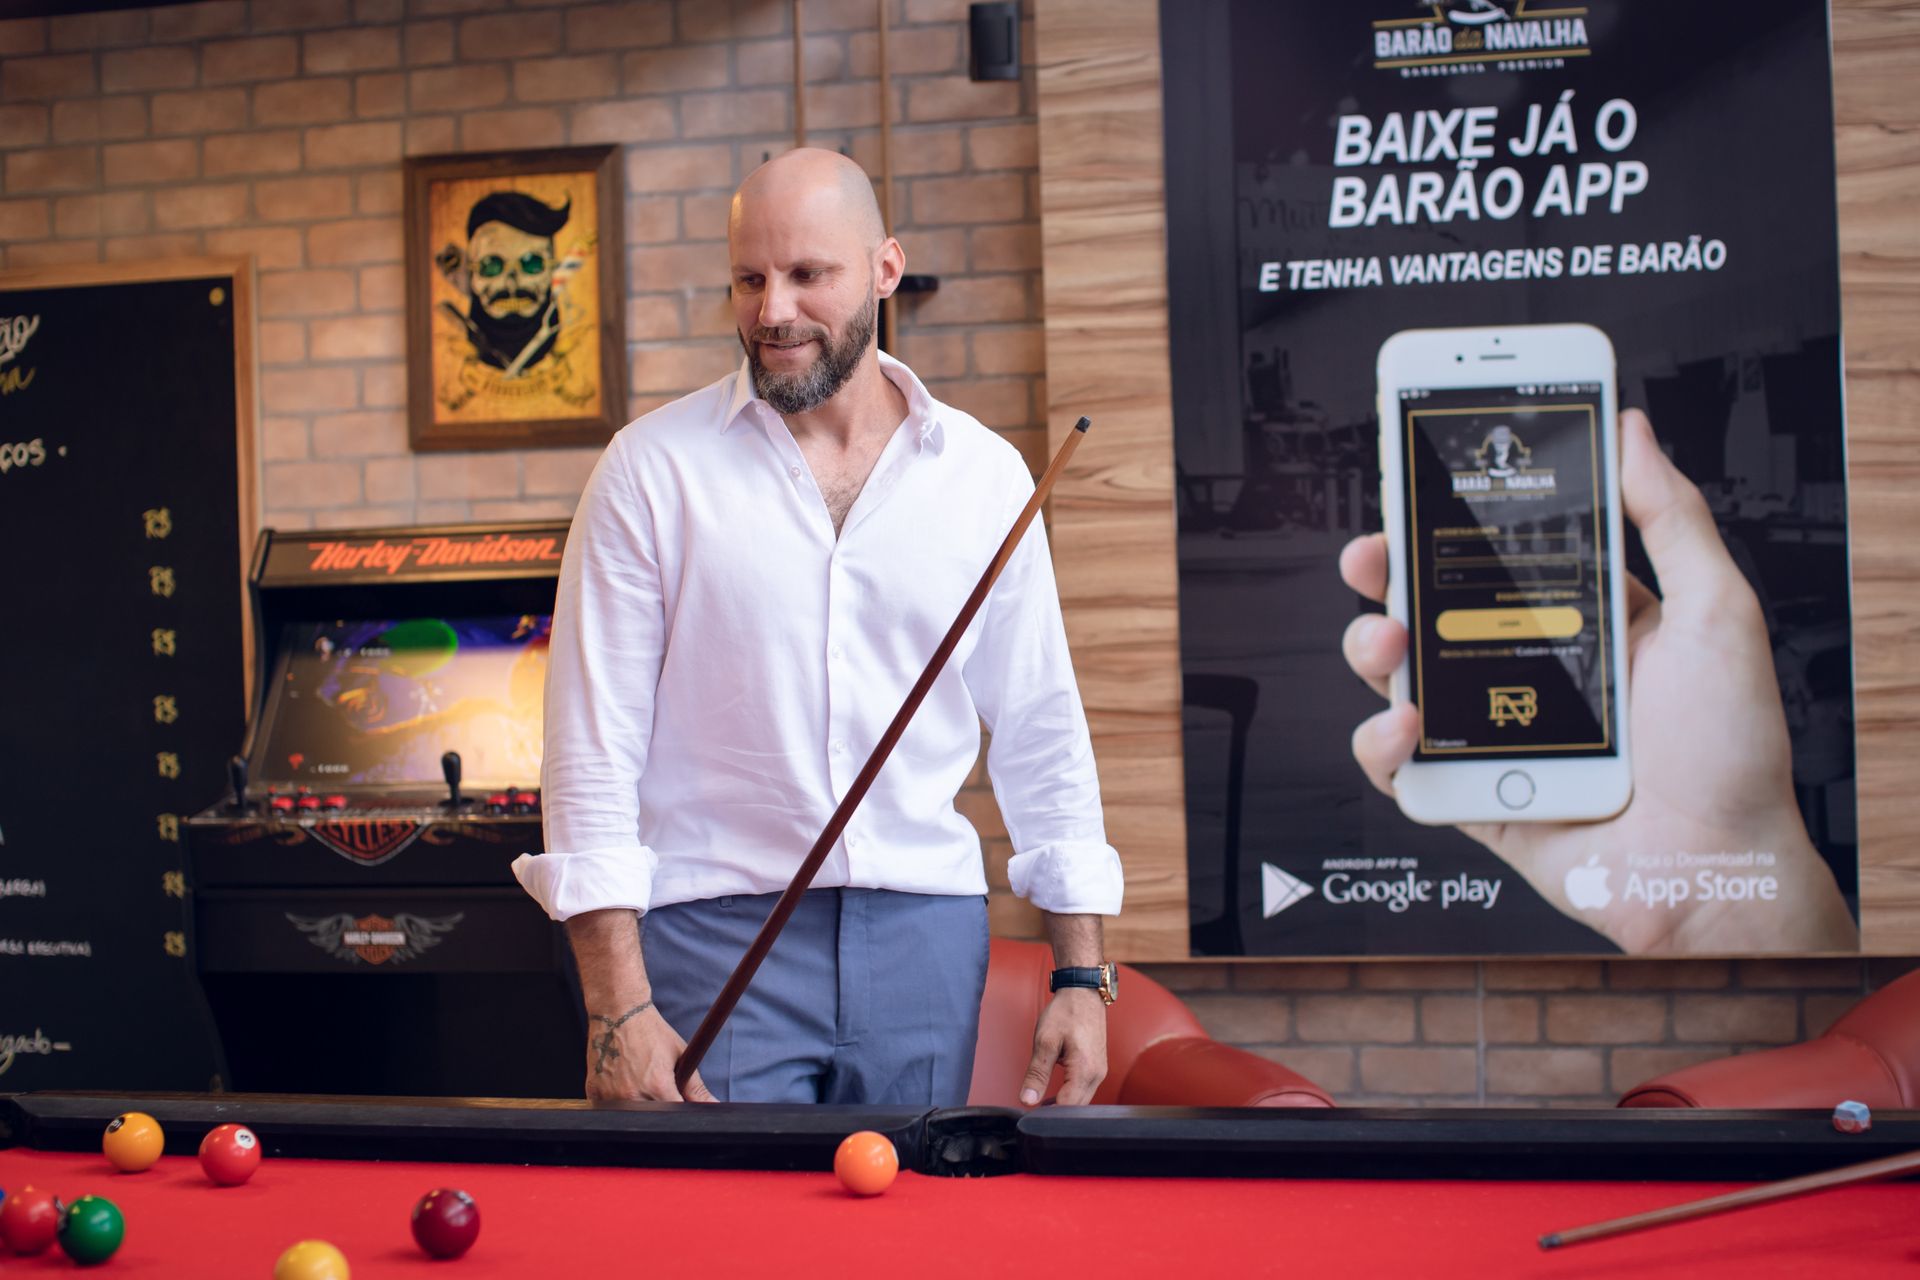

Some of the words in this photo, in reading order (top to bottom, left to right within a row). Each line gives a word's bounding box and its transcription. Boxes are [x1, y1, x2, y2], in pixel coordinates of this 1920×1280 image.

[1374, 22, 1453, 57] BARÃO
[1484, 18, 1588, 50] NAVALHA
[1333, 106, 1499, 167] BAIXE
[1508, 89, 1579, 157] JÁ
[1595, 98, 1638, 152] O
[1328, 159, 1525, 228] BARÃO
[1532, 160, 1650, 218] APP
[1259, 261, 1282, 292] E
[1286, 256, 1384, 291] TENHA
[1389, 246, 1564, 285] VANTAGENS
[1569, 244, 1614, 277] DE
[1617, 234, 1728, 274] BARÃO
[308, 534, 562, 575] Harley-Davidson
[1676, 850, 1753, 867] Download
[1322, 871, 1433, 913] Google
[1441, 872, 1502, 910] play
[1623, 872, 1690, 909] App
[1695, 869, 1779, 901] Store
